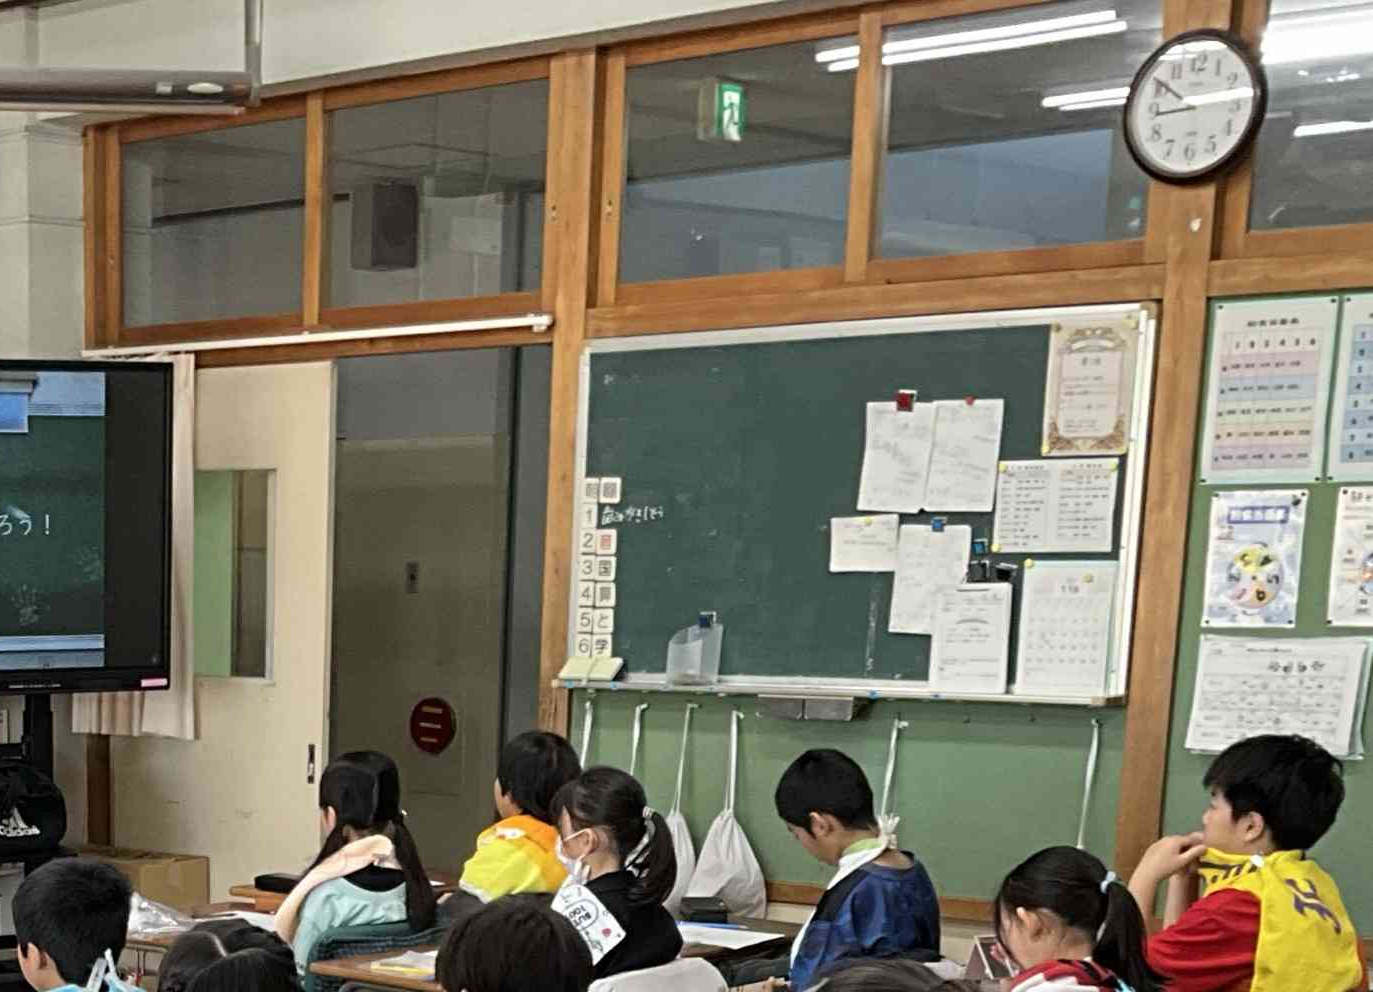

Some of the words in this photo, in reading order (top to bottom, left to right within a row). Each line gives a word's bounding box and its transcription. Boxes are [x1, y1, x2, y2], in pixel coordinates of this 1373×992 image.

[1190, 53, 1208, 72] 12
[1151, 123, 1162, 141] 8
[1164, 138, 1175, 159] 7
[583, 532, 594, 549] 2
[580, 612, 590, 627] 5
[578, 639, 589, 653] 6
